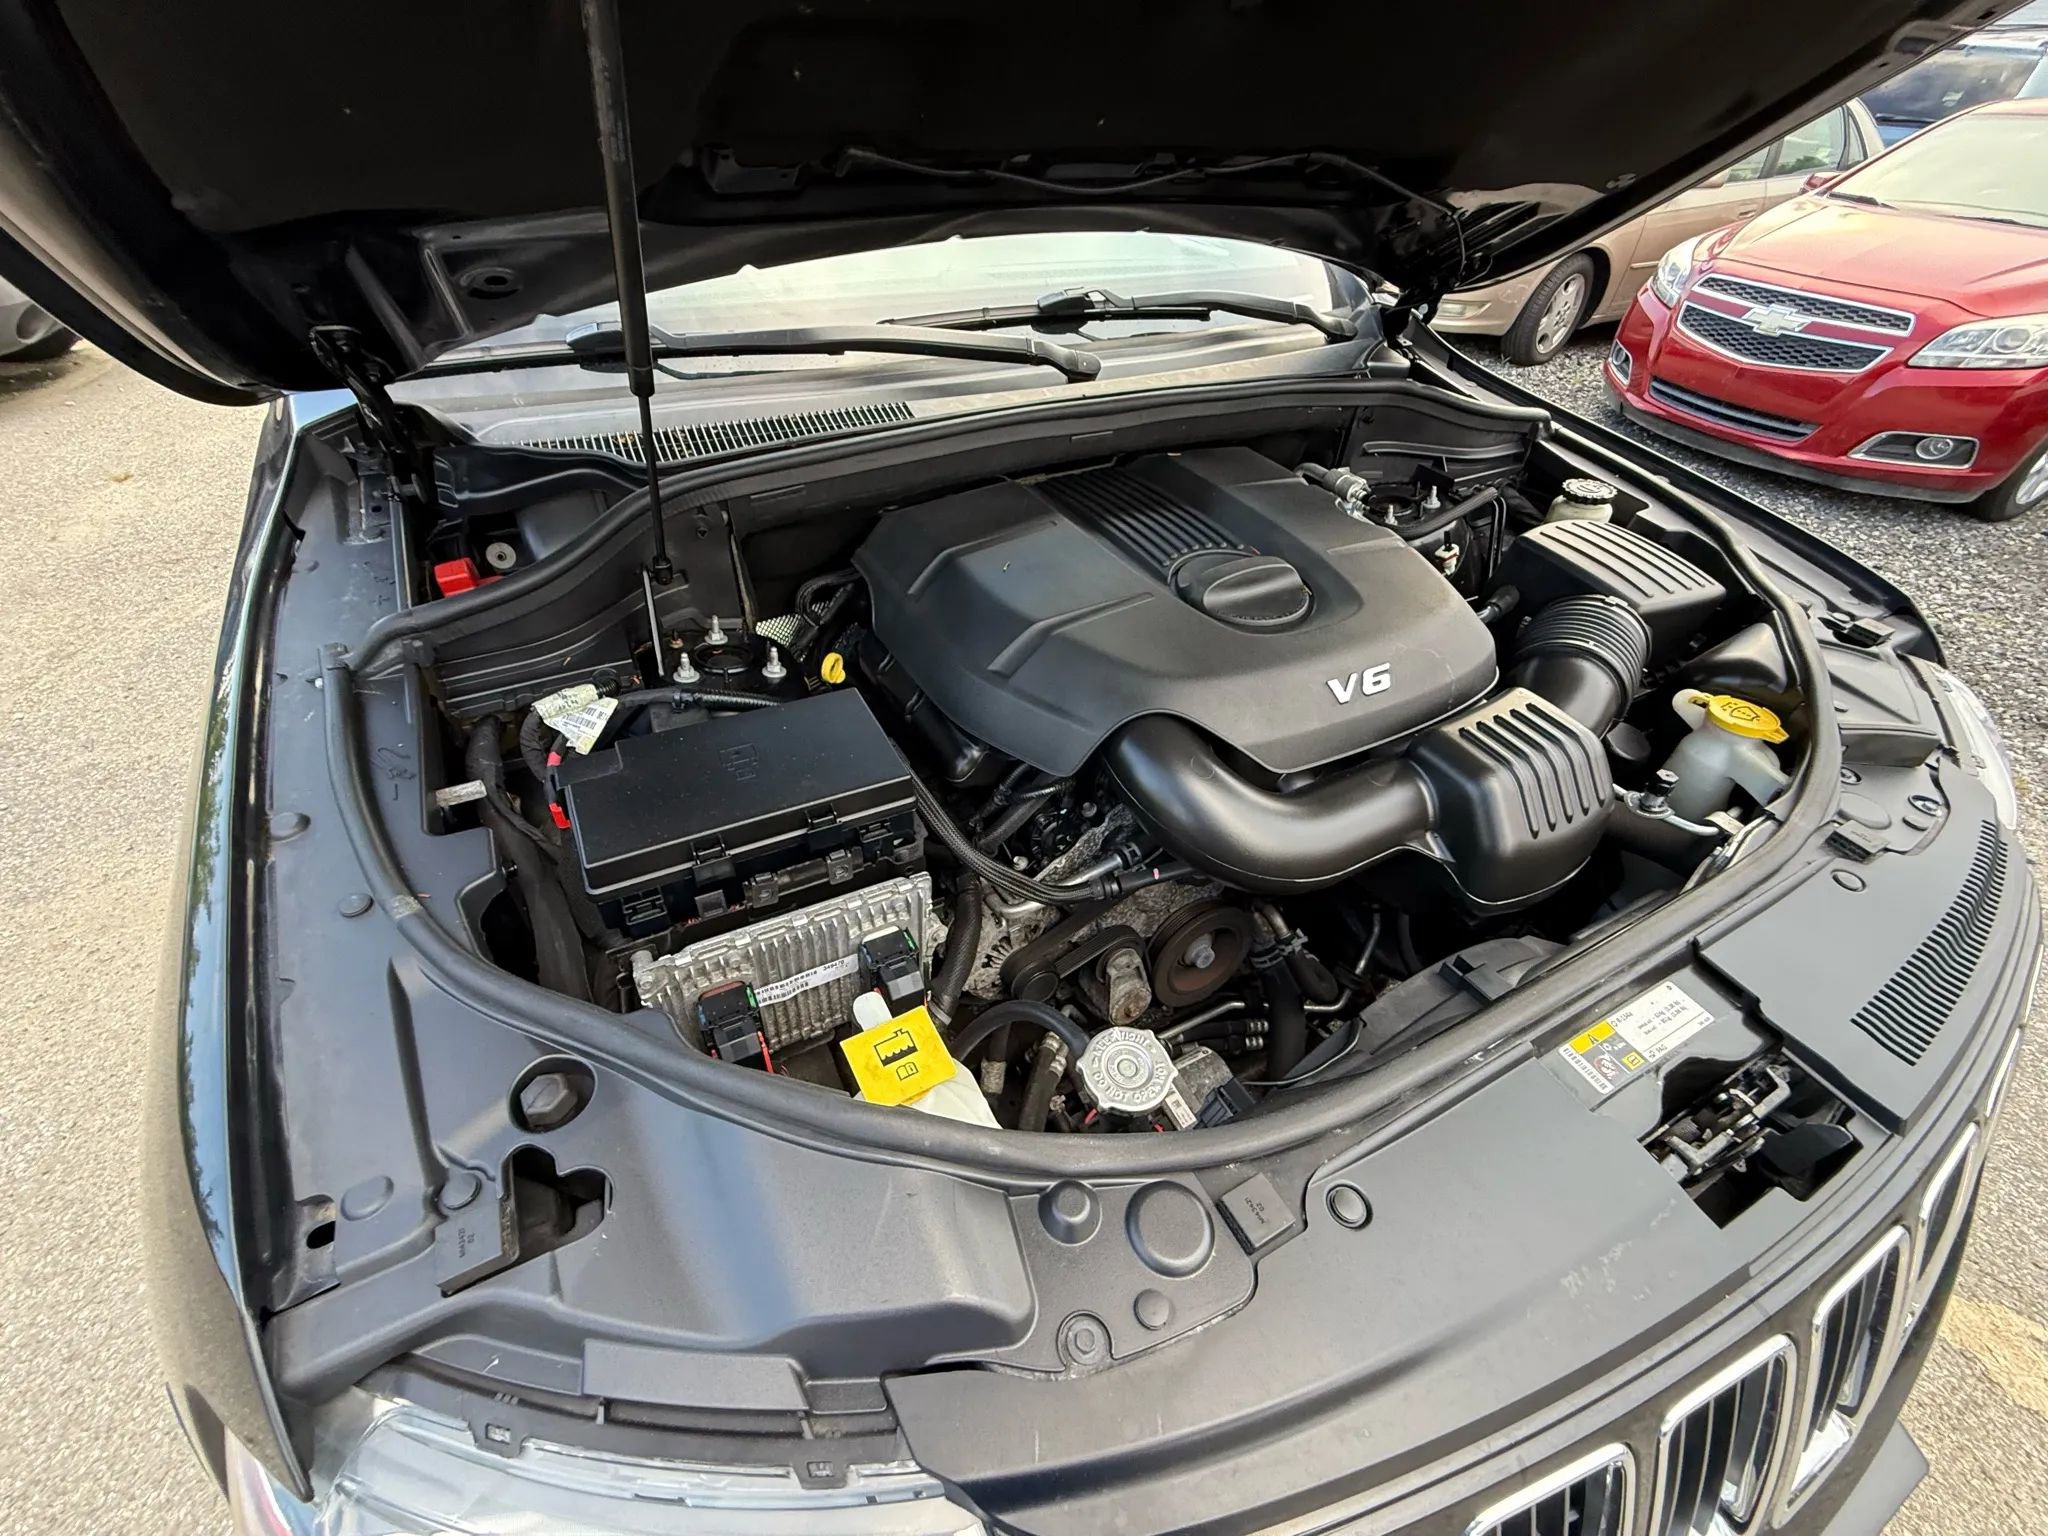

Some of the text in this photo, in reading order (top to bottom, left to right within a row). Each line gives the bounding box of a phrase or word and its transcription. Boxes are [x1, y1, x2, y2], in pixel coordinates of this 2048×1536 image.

[1326, 661, 1391, 705] V6
[1092, 1070, 1107, 1087] DO
[1104, 1085, 1129, 1103] NOT
